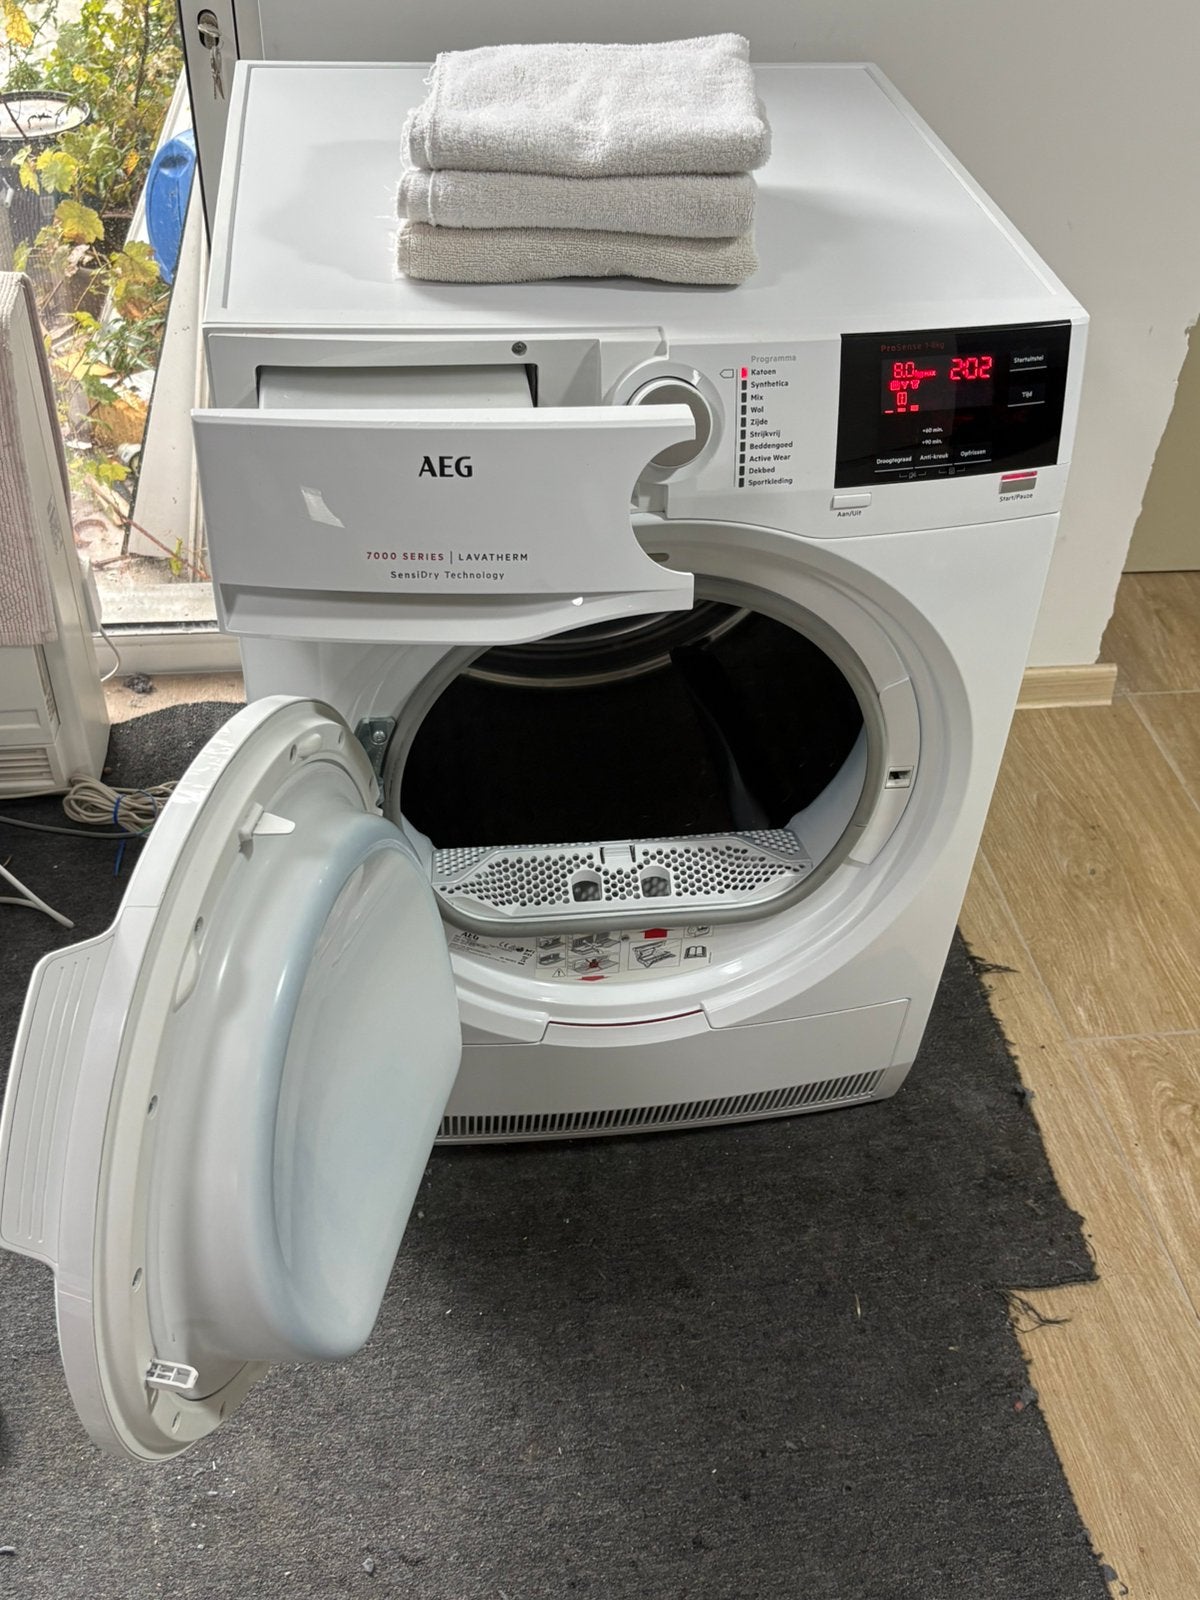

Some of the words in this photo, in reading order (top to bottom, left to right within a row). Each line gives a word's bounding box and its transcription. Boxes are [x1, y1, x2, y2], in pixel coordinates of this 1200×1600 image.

[750, 355, 797, 364] Programma
[750, 368, 777, 376] Katoen
[949, 356, 993, 380] 2:02
[750, 380, 789, 389] Synthetica
[750, 418, 769, 427] Zijde
[749, 430, 781, 439] Strijkvrij
[749, 441, 794, 450] Beddengoed
[960, 449, 987, 458] Opfrissen
[749, 455, 772, 463] Active
[772, 454, 791, 462] Wear
[876, 456, 913, 466] Droogtegraad
[418, 455, 473, 478] AEG
[748, 466, 776, 474] Dekbed
[748, 478, 793, 487] Sportkleding
[836, 510, 862, 518] Aan/Uit
[366, 552, 397, 561] 7000
[402, 552, 445, 561] SERIES
[458, 553, 529, 562] LAVATHERM
[390, 570, 440, 580] SensiDry
[444, 570, 505, 581] Technology
